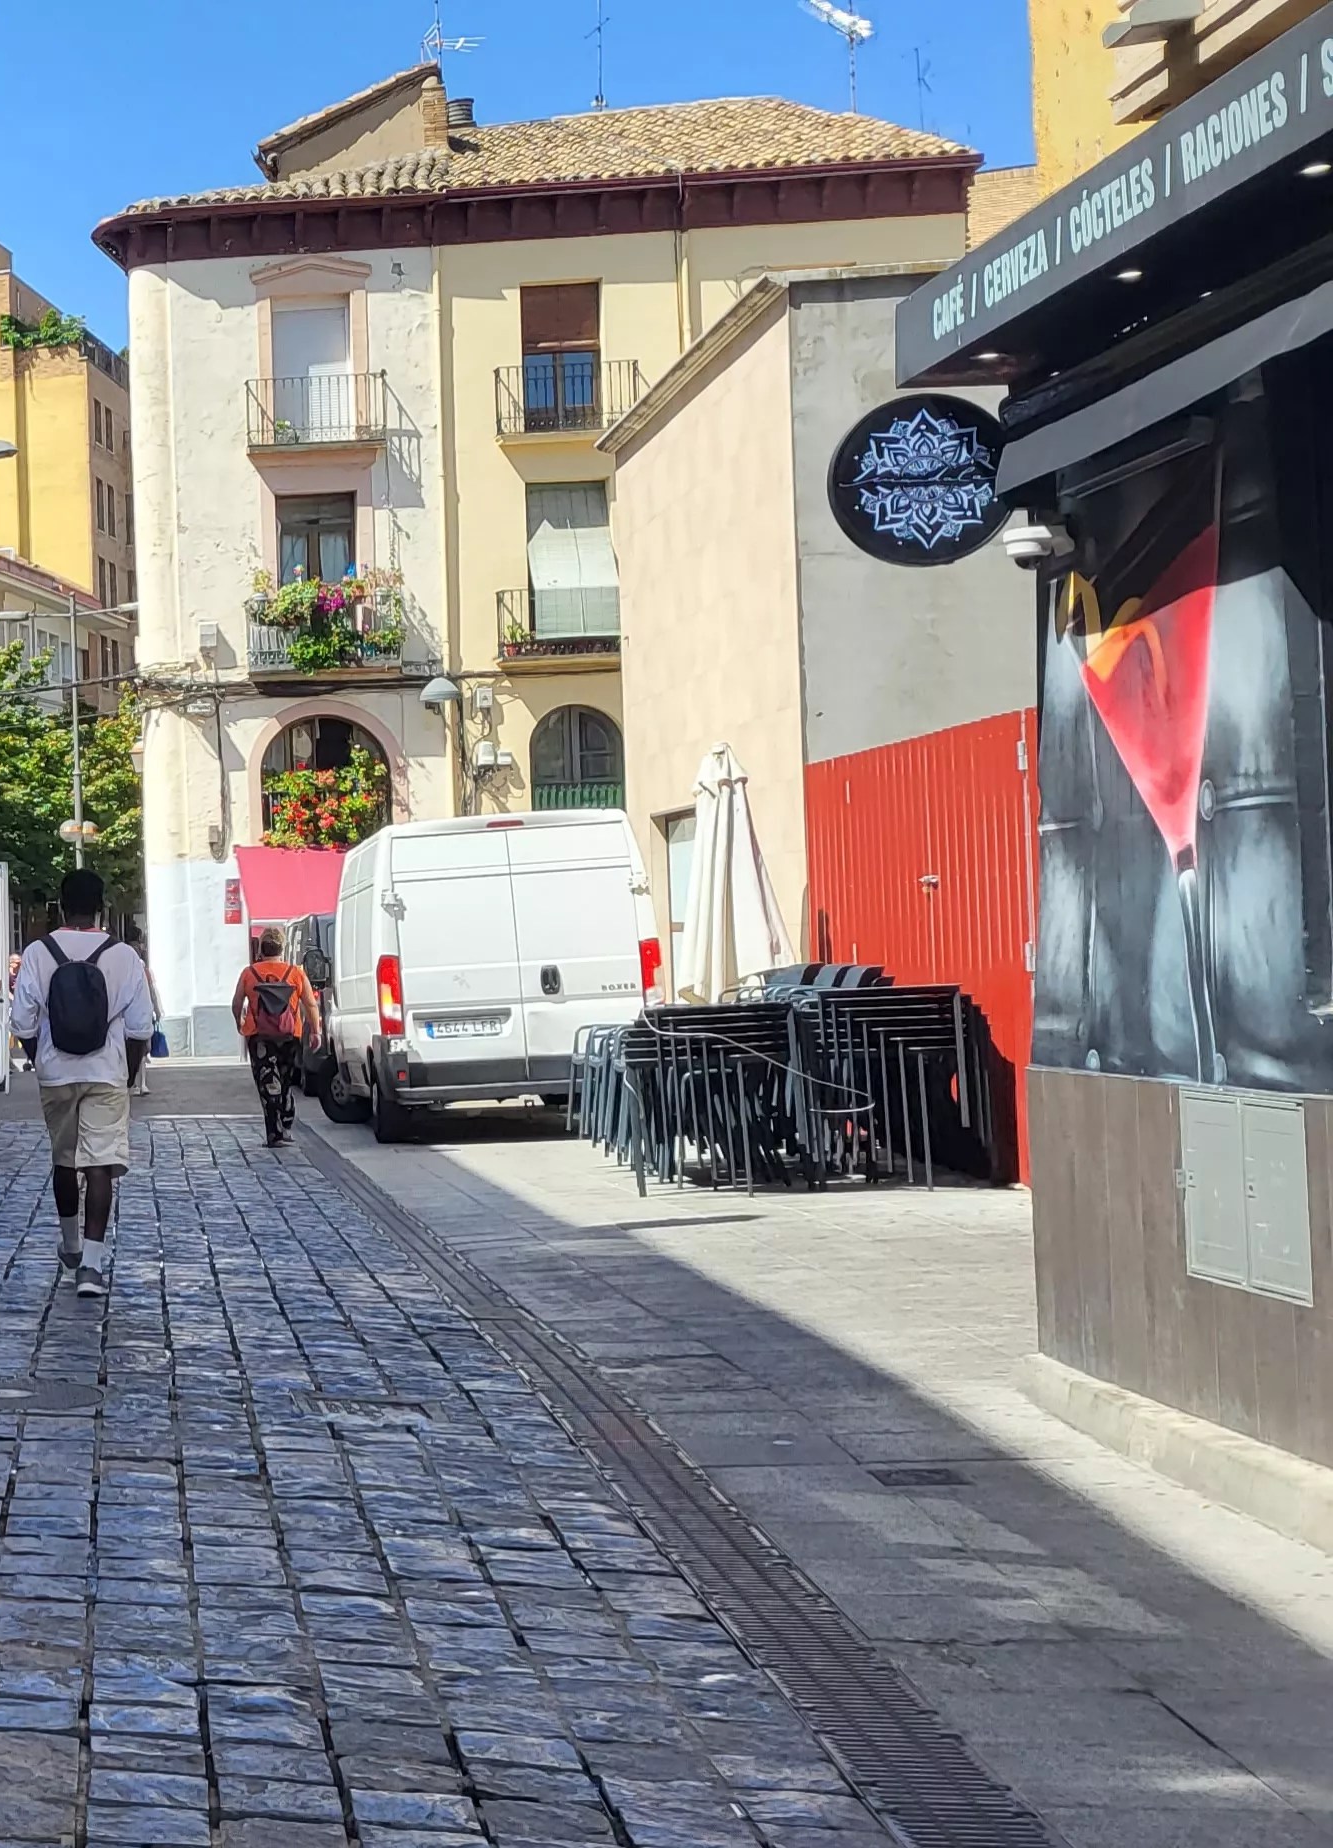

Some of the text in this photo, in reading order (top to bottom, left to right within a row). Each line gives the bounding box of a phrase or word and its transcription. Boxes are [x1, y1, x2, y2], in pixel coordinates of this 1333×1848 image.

[933, 273, 965, 341] CAFÉ
[983, 229, 1049, 308] CERVEZA
[1069, 155, 1155, 254] CÓCTELES
[1180, 71, 1288, 184] RACIONES
[1321, 38, 1333, 97] S
[601, 982, 637, 991] BOXER
